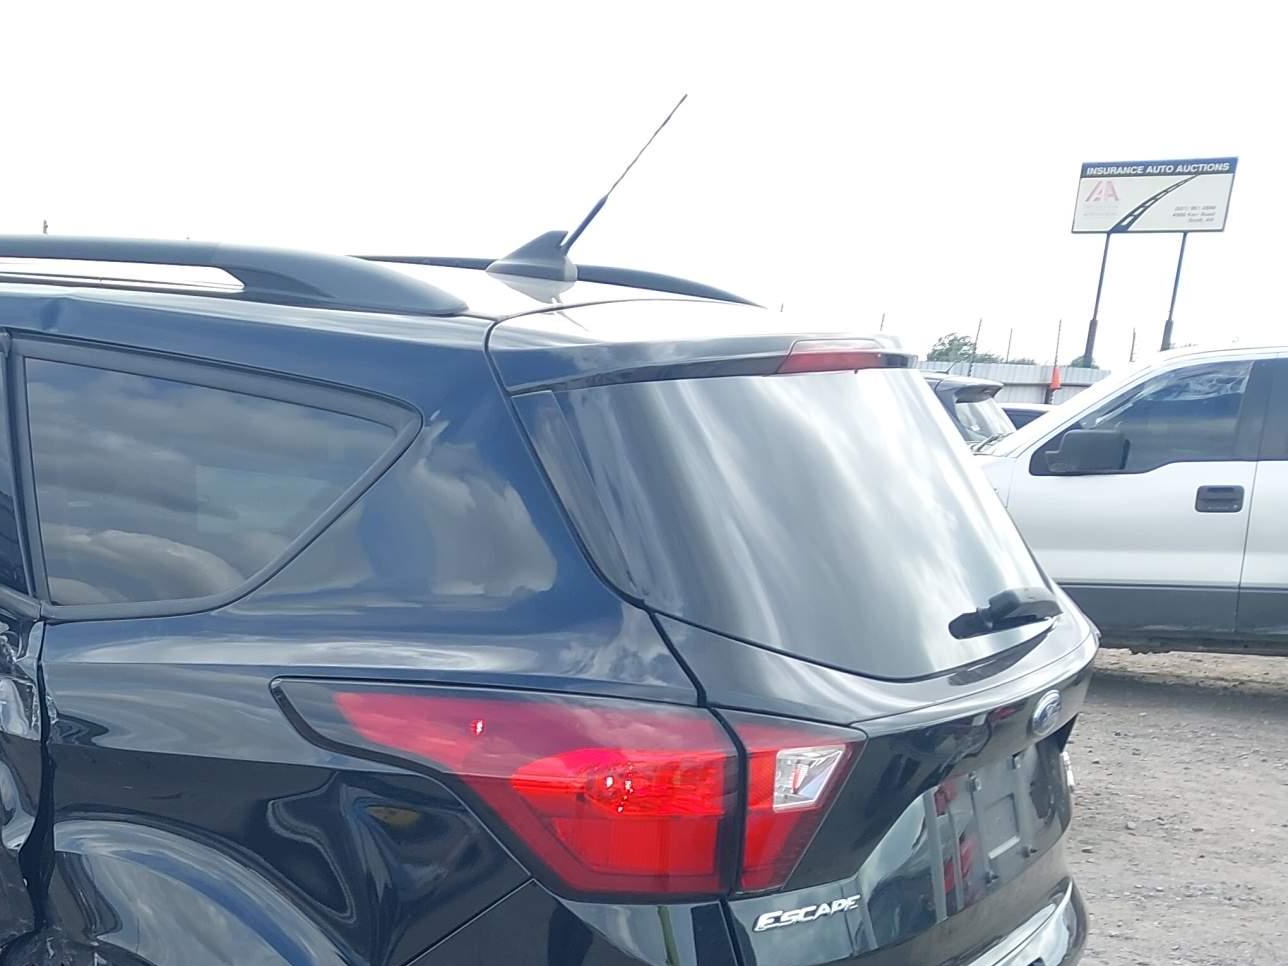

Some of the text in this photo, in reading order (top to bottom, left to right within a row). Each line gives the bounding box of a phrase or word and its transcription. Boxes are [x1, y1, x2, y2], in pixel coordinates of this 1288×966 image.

[1086, 162, 1231, 176] INSURANCE AUTO AUCTIONS
[754, 894, 861, 932] ESCAPE
